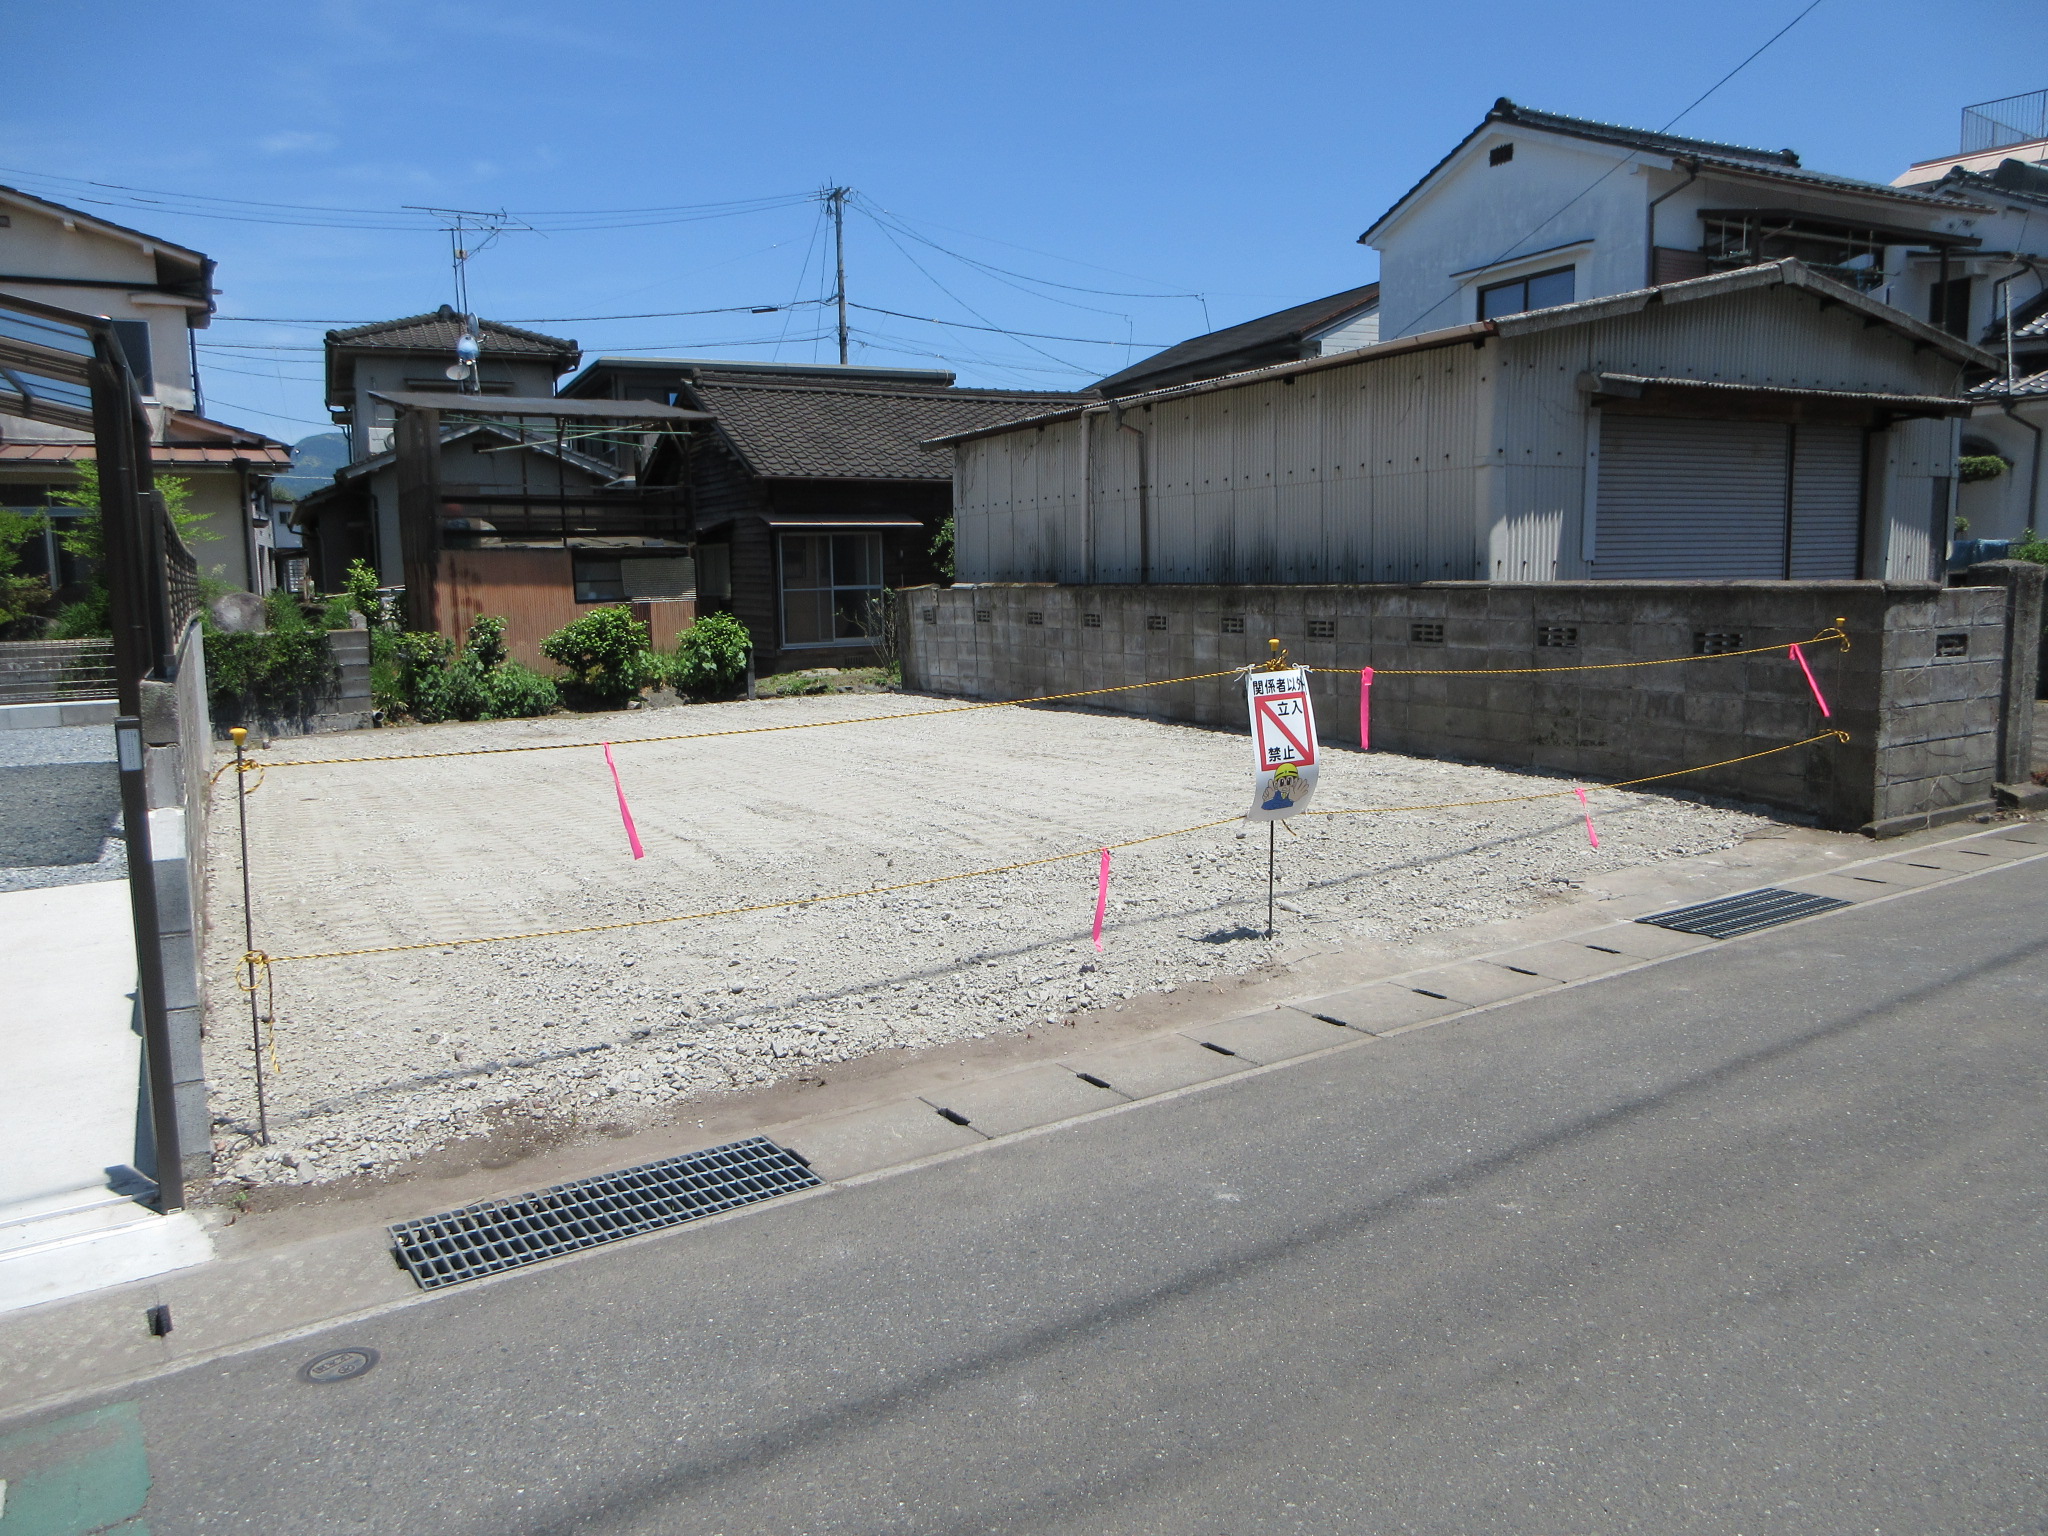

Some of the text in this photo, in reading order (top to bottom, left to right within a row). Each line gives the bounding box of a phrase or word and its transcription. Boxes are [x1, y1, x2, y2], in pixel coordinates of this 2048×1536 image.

[1252, 677, 1306, 695] 関係者以外
[1277, 700, 1302, 716] 立入
[1268, 745, 1295, 762] 禁止
